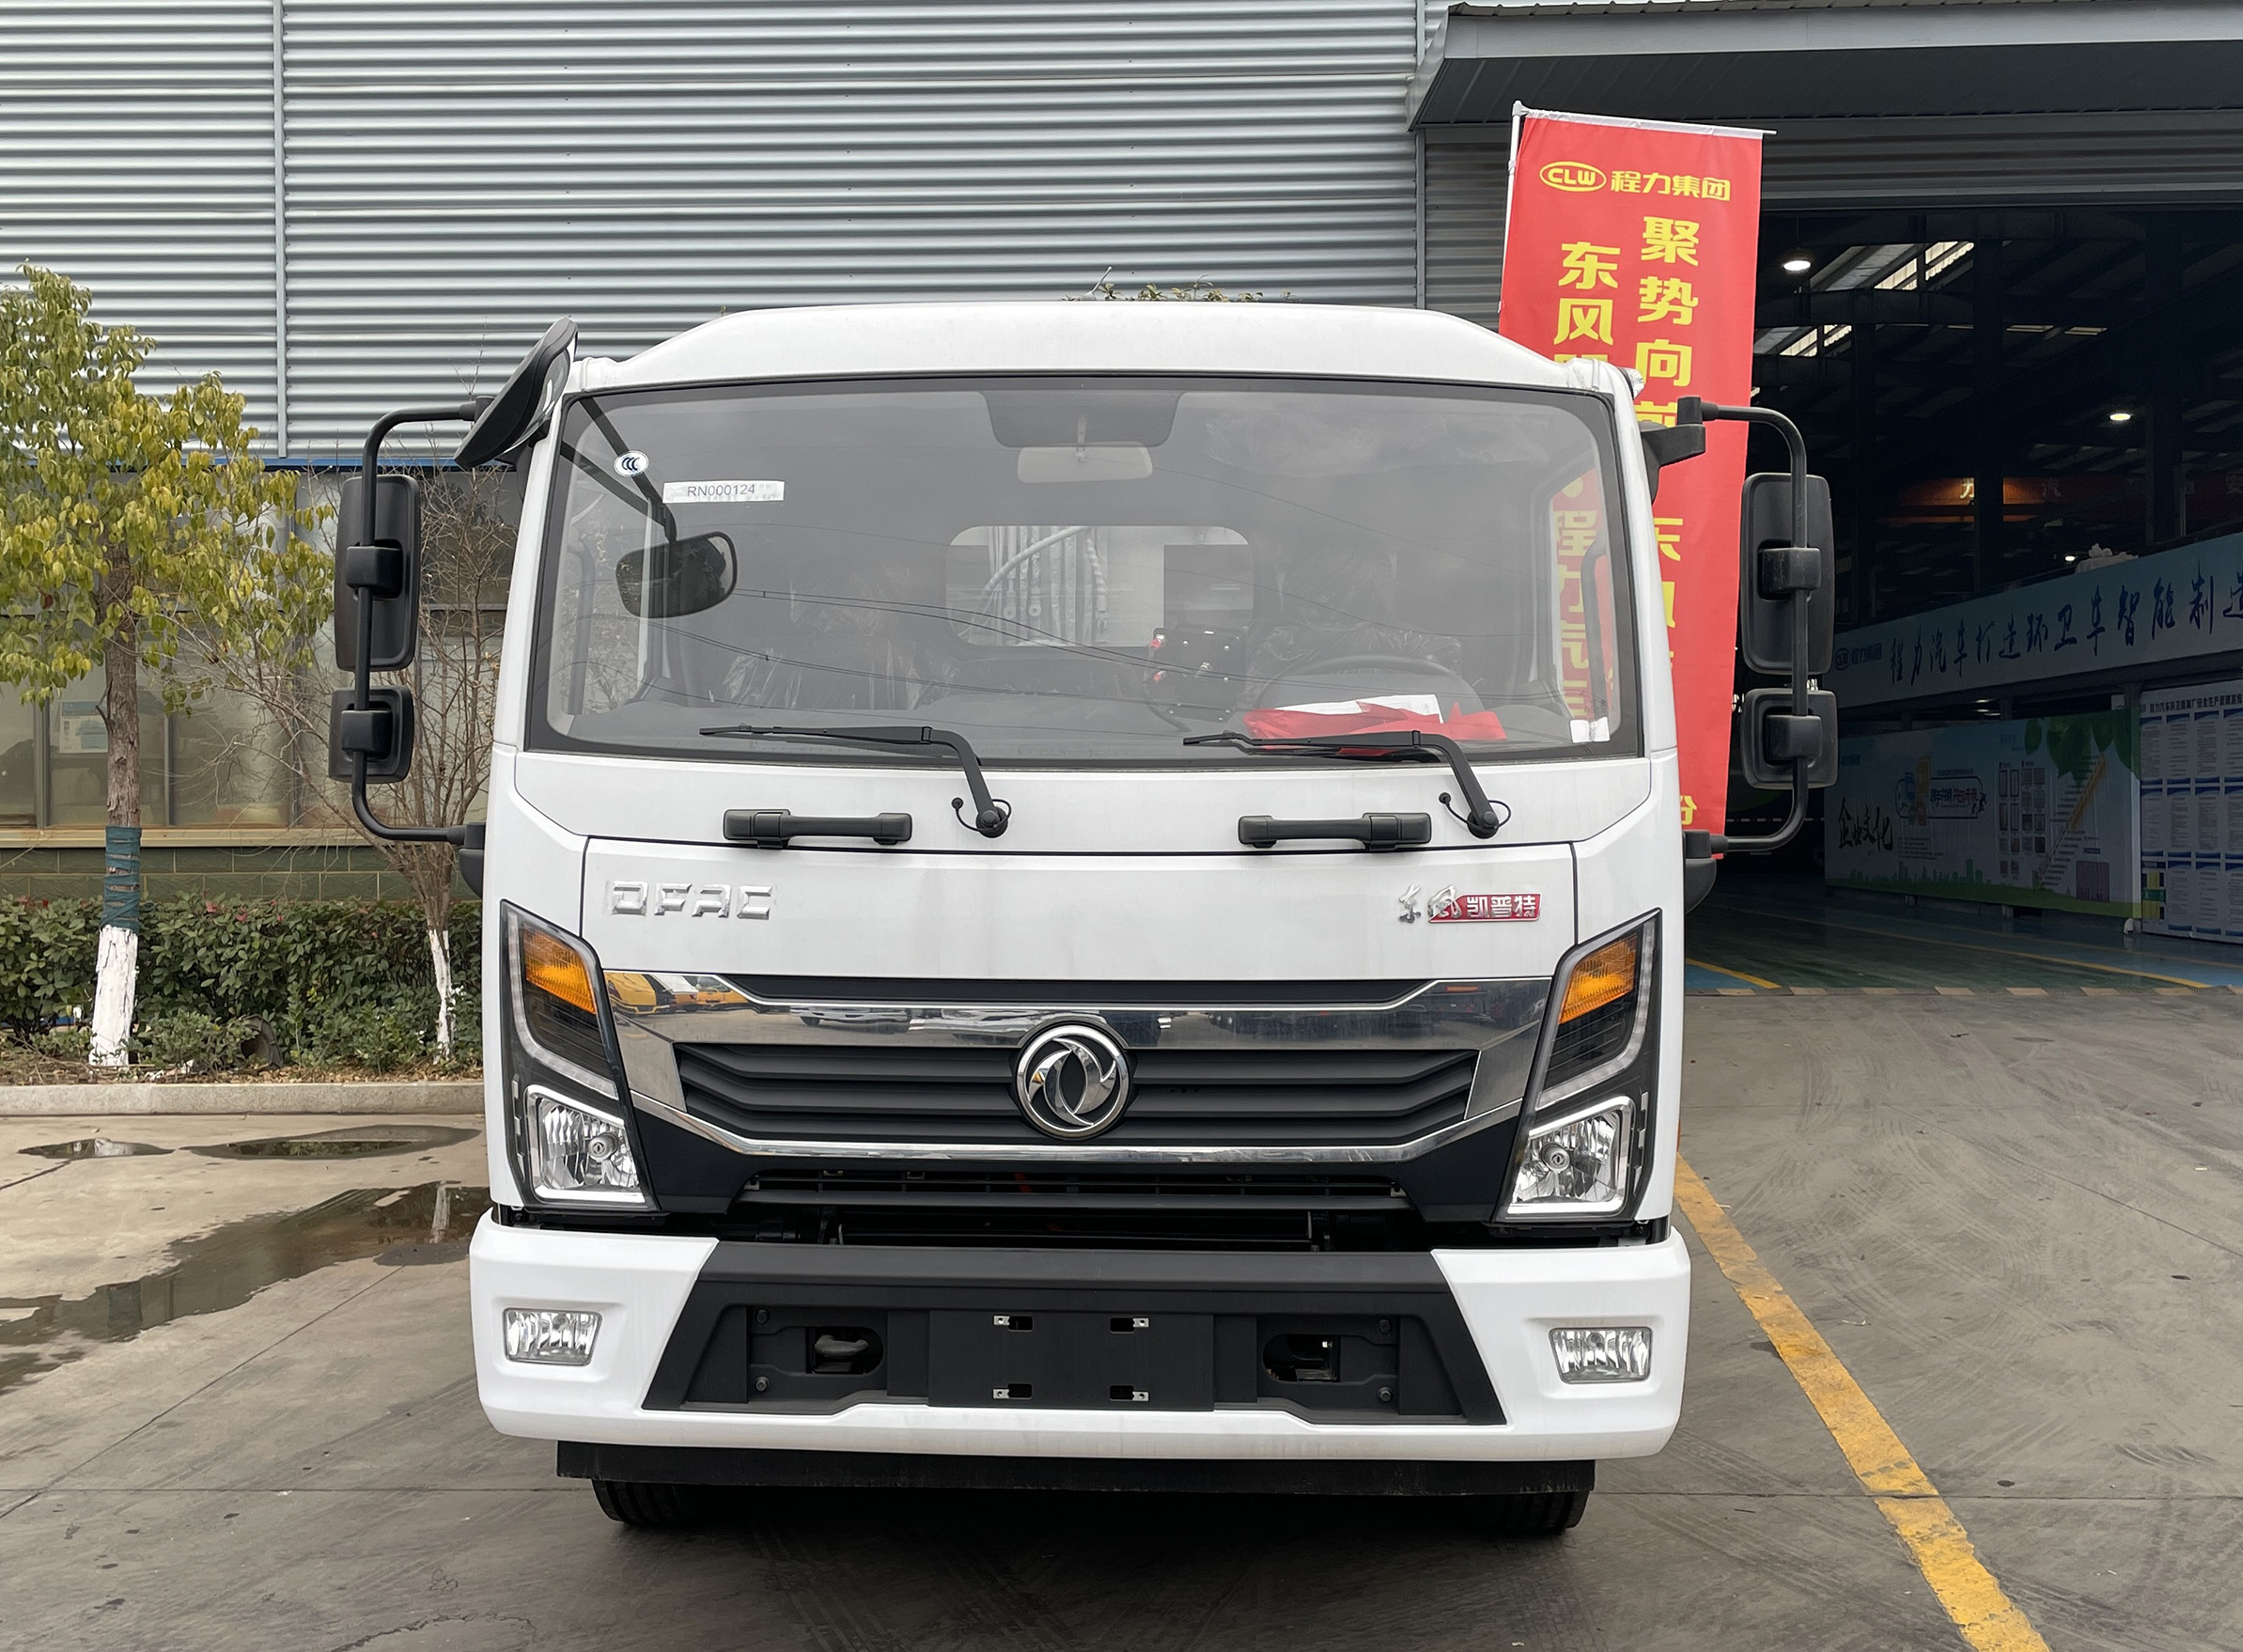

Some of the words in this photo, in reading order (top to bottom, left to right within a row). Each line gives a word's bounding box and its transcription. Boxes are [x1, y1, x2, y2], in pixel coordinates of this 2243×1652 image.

[1610, 170, 1731, 202] 程力集团
[1553, 241, 1622, 364] 东风
[687, 483, 756, 497] RN000124
[612, 881, 773, 920] DFAC
[1466, 895, 1536, 918] 凯普特
